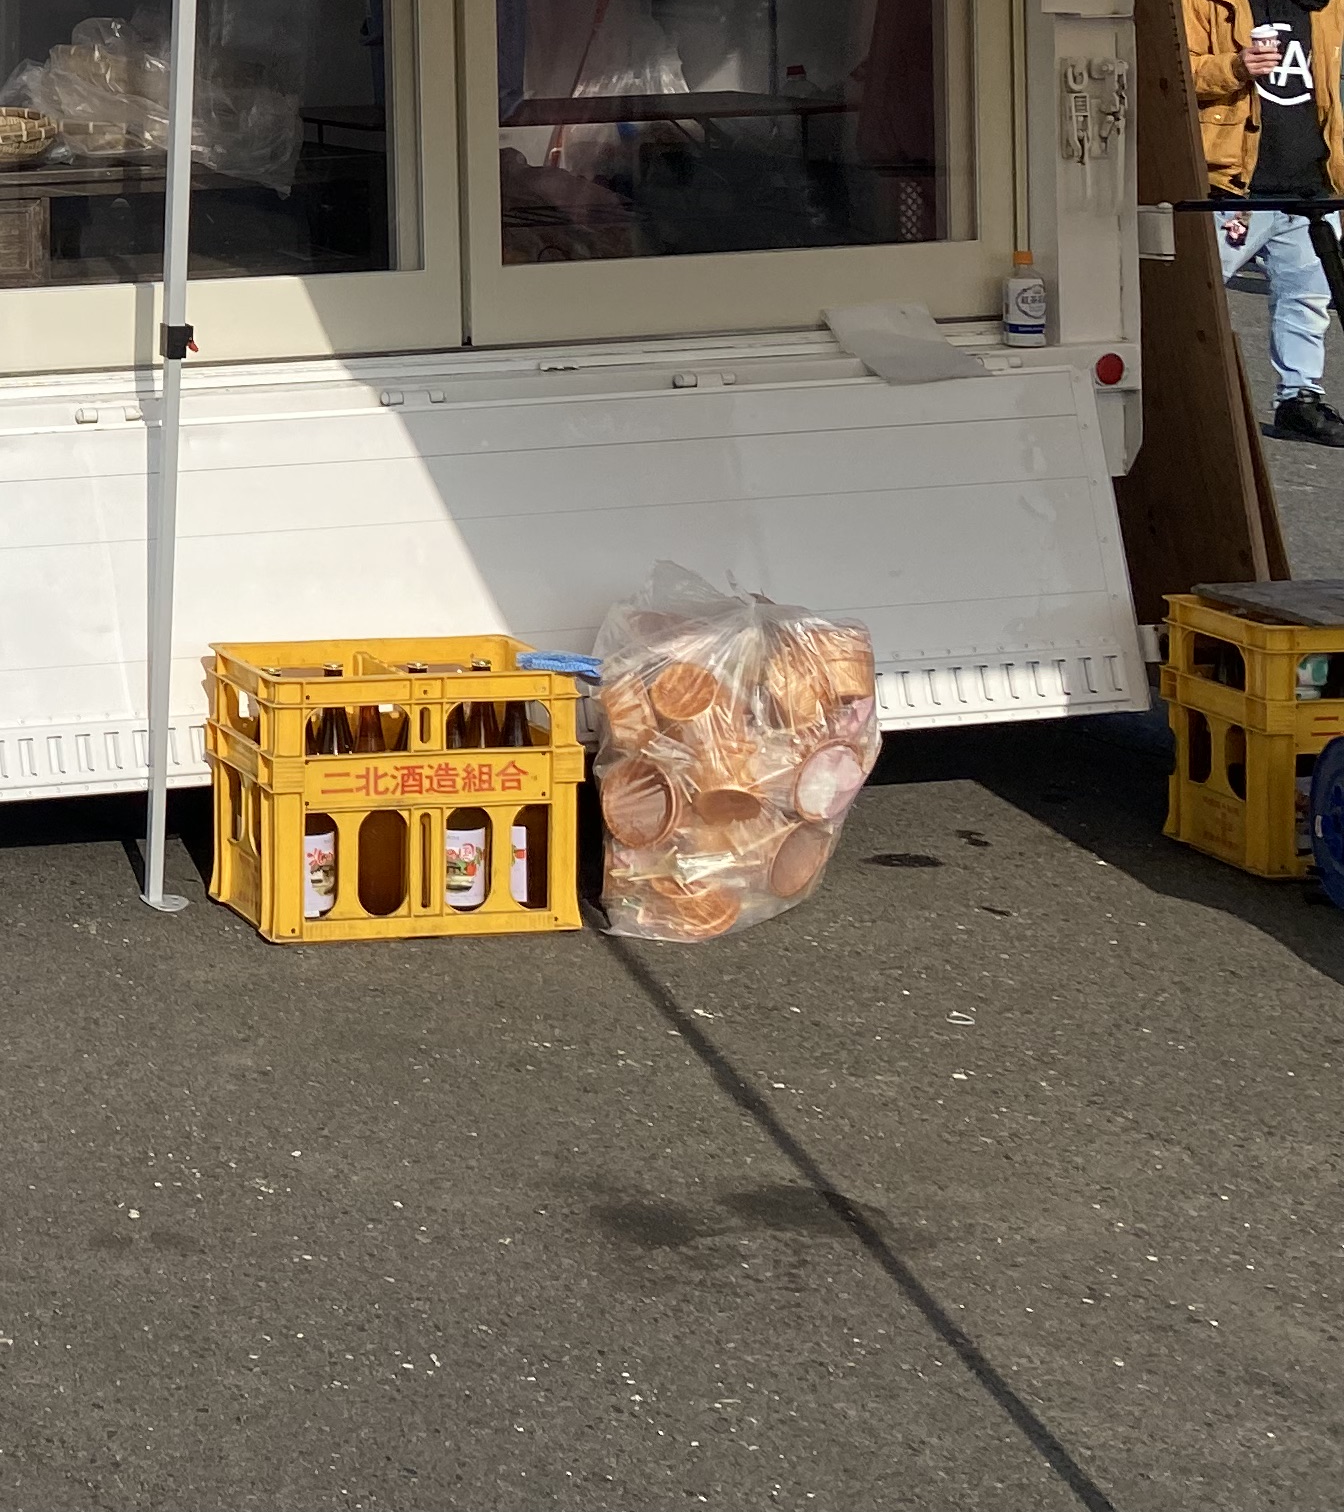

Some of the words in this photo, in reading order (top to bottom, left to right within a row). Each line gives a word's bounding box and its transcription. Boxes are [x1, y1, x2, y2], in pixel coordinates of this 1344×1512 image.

[320, 760, 530, 797] 二北酒造組合
